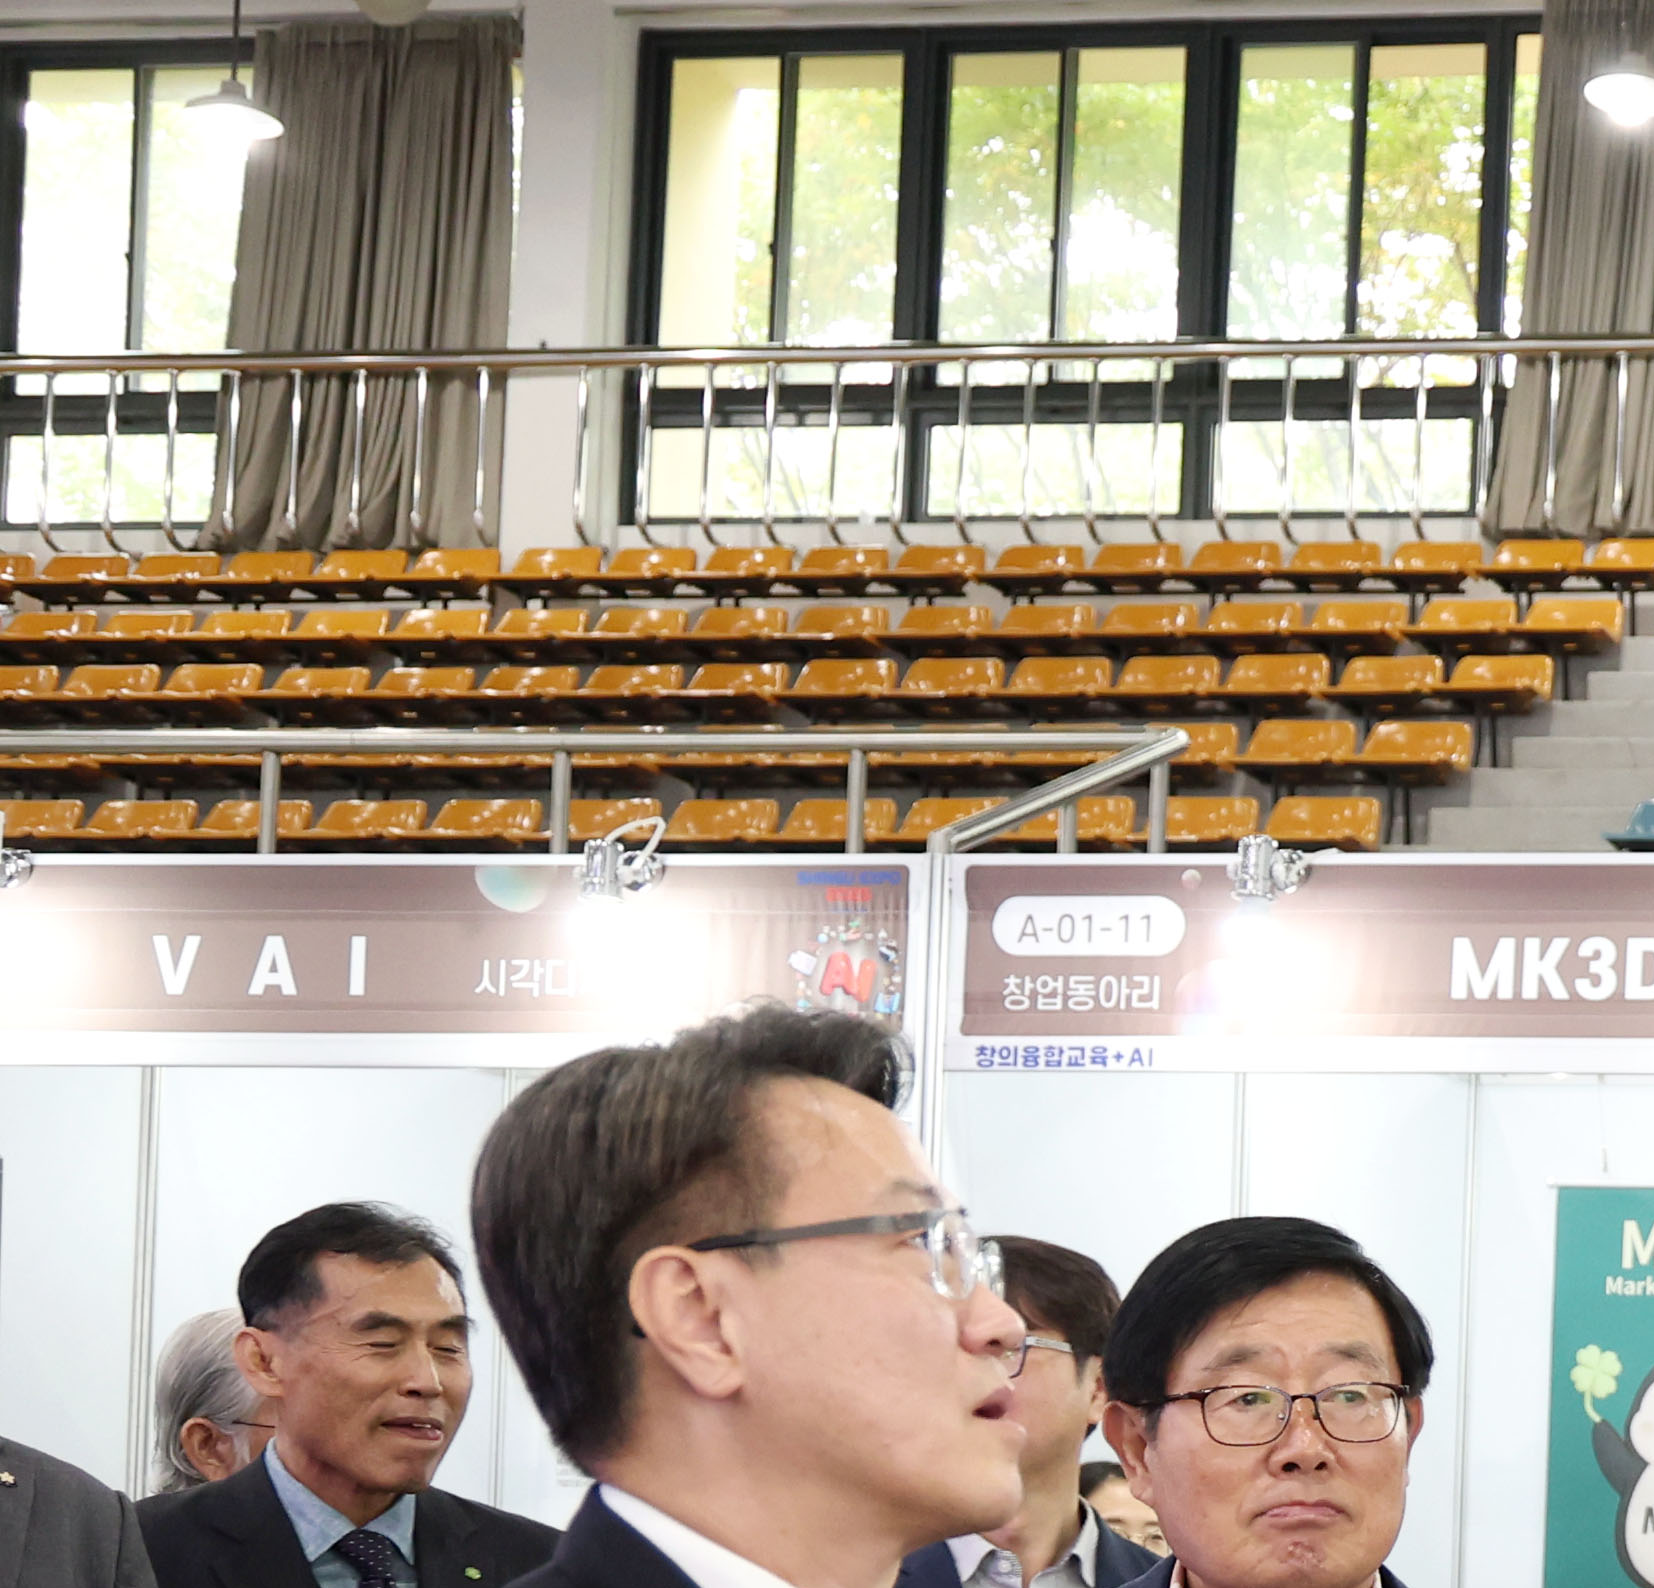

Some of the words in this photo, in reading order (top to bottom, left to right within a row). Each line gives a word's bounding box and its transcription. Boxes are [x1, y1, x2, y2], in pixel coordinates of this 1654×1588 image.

[1017, 913, 1152, 944] A-01-11
[1002, 974, 1161, 1011] 창업동아리
[976, 1045, 1153, 1069] 창의융합교육+AI
